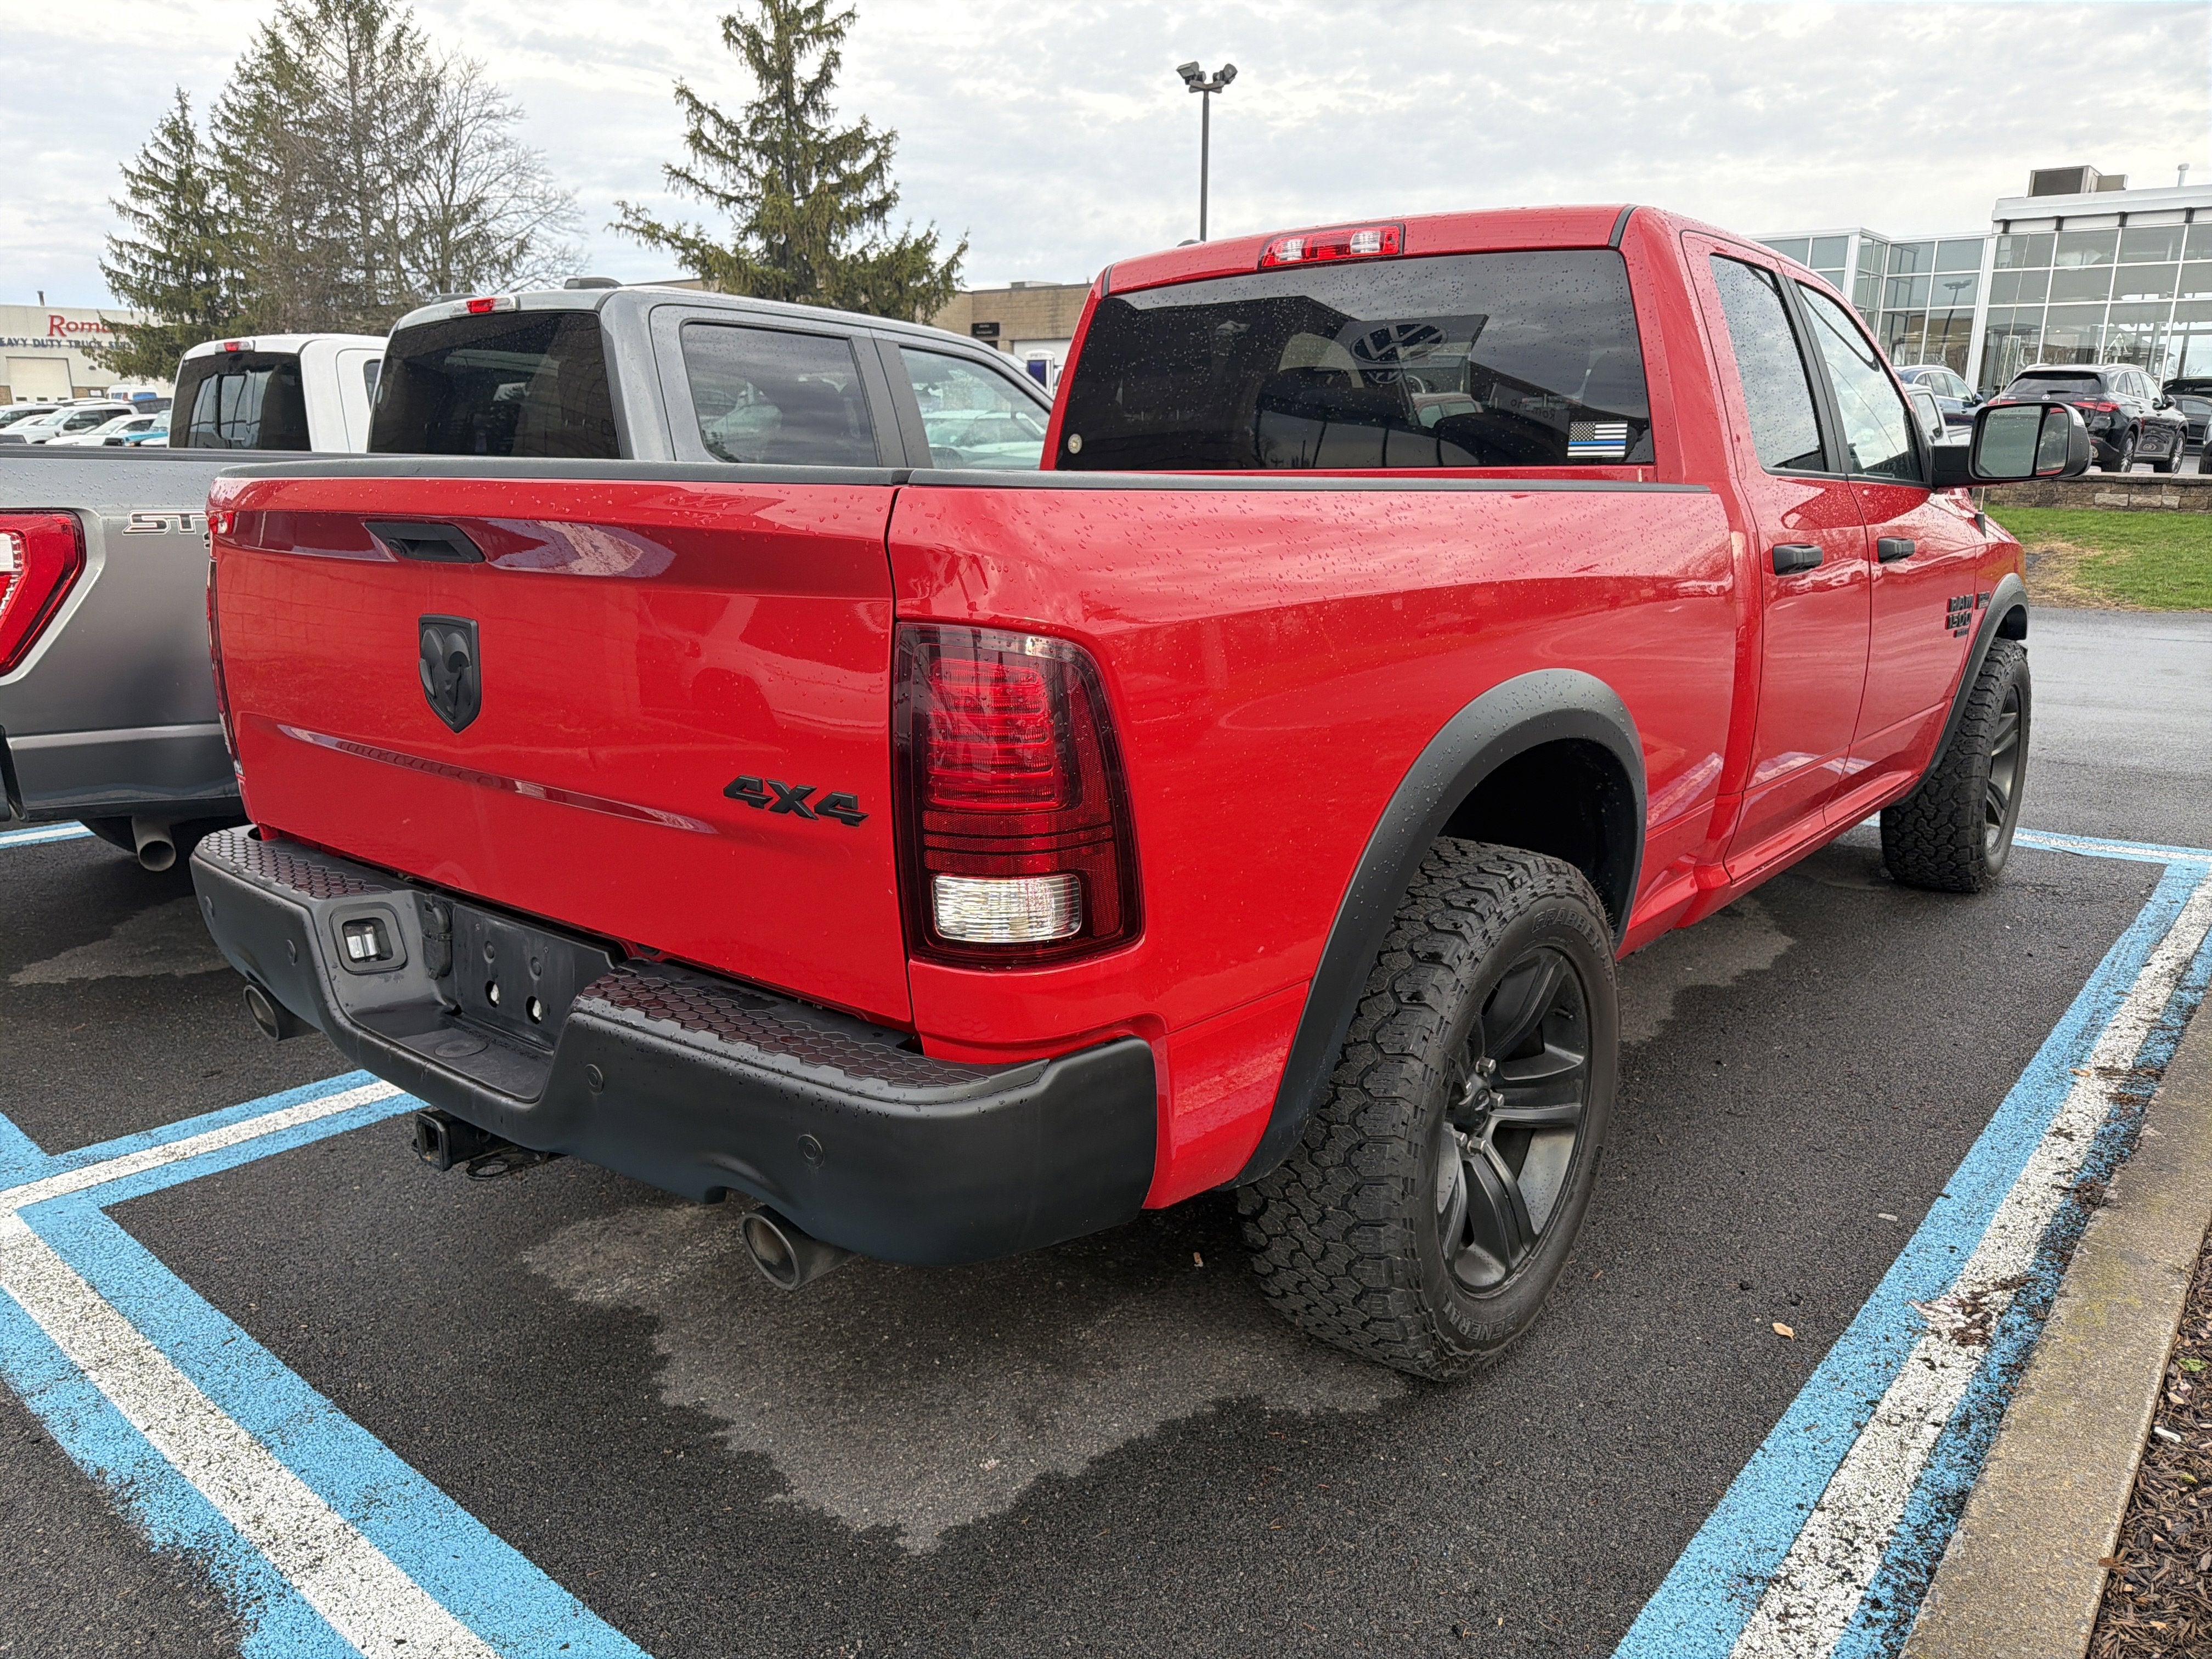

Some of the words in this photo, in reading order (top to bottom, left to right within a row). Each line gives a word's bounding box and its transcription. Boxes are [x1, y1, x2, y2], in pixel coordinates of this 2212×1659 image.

[47, 314, 140, 337] Rom
[0, 337, 27, 347] EAVY
[32, 338, 62, 348] DUTY
[122, 509, 208, 536] ST
[1948, 594, 1974, 612] RAM
[1946, 611, 1971, 630] 1500
[1531, 907, 1601, 953] GRABBER
[1442, 1290, 1520, 1341] GENERAL
